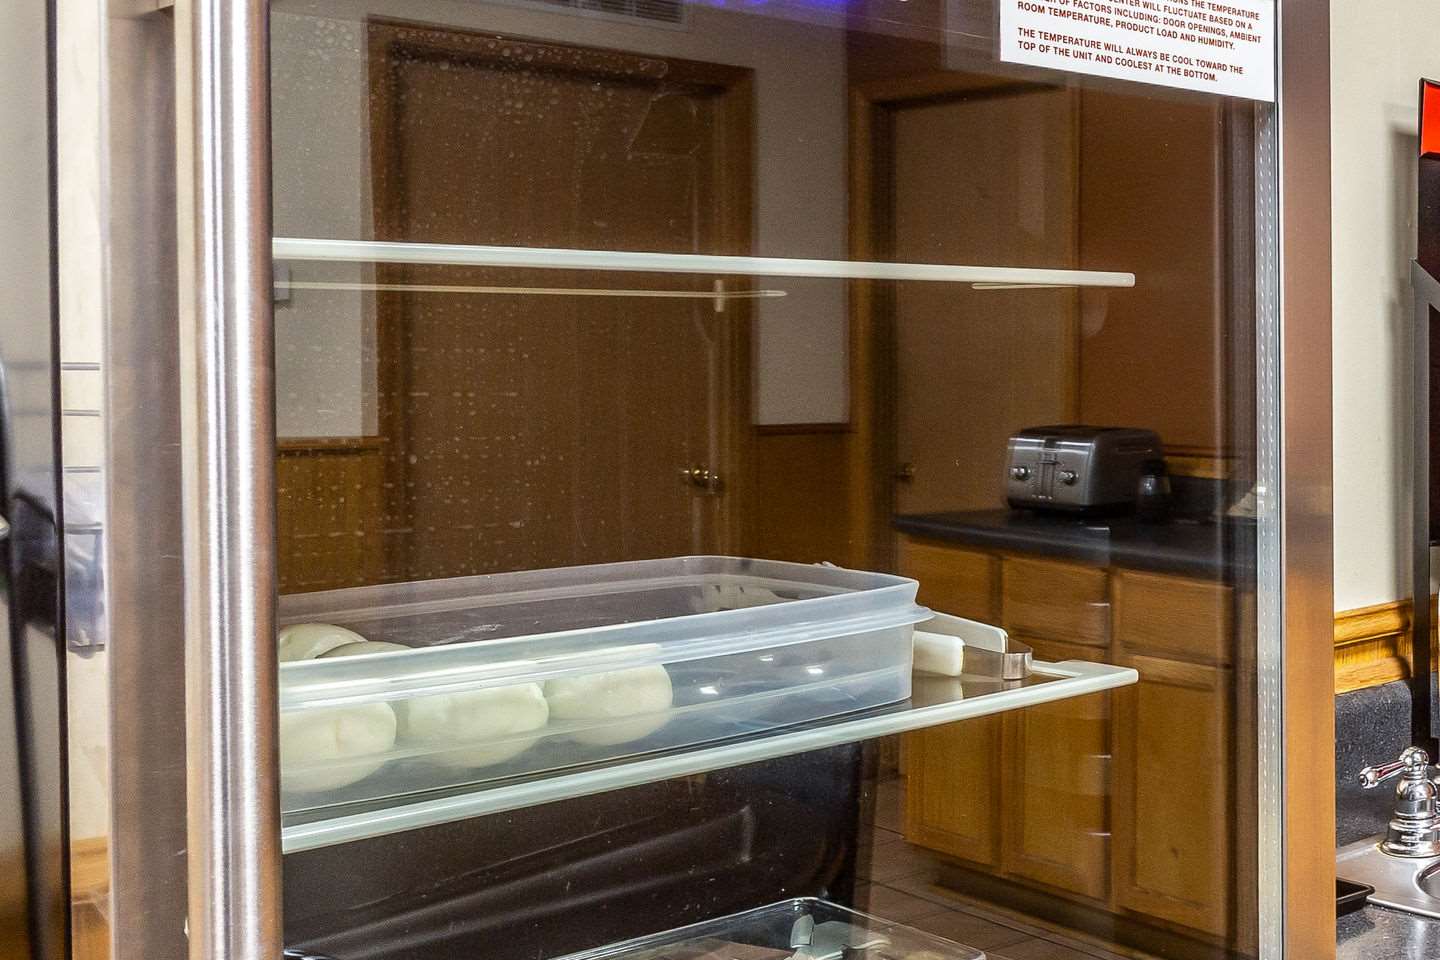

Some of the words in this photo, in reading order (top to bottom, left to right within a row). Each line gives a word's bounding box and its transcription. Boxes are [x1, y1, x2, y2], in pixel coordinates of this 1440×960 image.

[1018, 1, 1045, 14] ROOM
[1048, 6, 1113, 28] TEMPERATURE,
[1116, 20, 1154, 34] PRODUCT
[1157, 28, 1178, 39] LOAD
[1180, 33, 1196, 43] AND
[1198, 36, 1236, 50] HUMIDITY.
[1073, 0, 1112, 14] FACTORS
[1114, 7, 1160, 24] INCLUDING:
[1163, 17, 1185, 28] DOOR
[1188, 22, 1228, 38] OPENINGS,
[1230, 31, 1261, 43] AMBIENT
[1143, 1, 1160, 12] WILL
[1163, 5, 1207, 21] FLUCTUATE
[1209, 14, 1233, 26] BASED
[1235, 20, 1246, 29] ON
[1207, 2, 1260, 20] TEMPERATURE
[1018, 27, 1036, 38] THE
[1038, 31, 1101, 50] TEMPERATURE
[1104, 42, 1125, 54] WILL
[1126, 47, 1157, 60] ALWAYS
[1160, 52, 1170, 62] BE
[1172, 54, 1193, 66] COOL
[1196, 58, 1227, 71] TOWARD
[1229, 65, 1243, 74] THE
[1018, 40, 1036, 51] TOP
[1038, 44, 1050, 53] OF
[1053, 46, 1072, 57] THE
[1072, 50, 1093, 60] UNIT
[1095, 54, 1113, 64] AND
[1114, 56, 1152, 71] COOLEST
[1155, 64, 1164, 72] AT
[1167, 66, 1181, 75] THE
[1183, 68, 1218, 81] BOTTOM.
